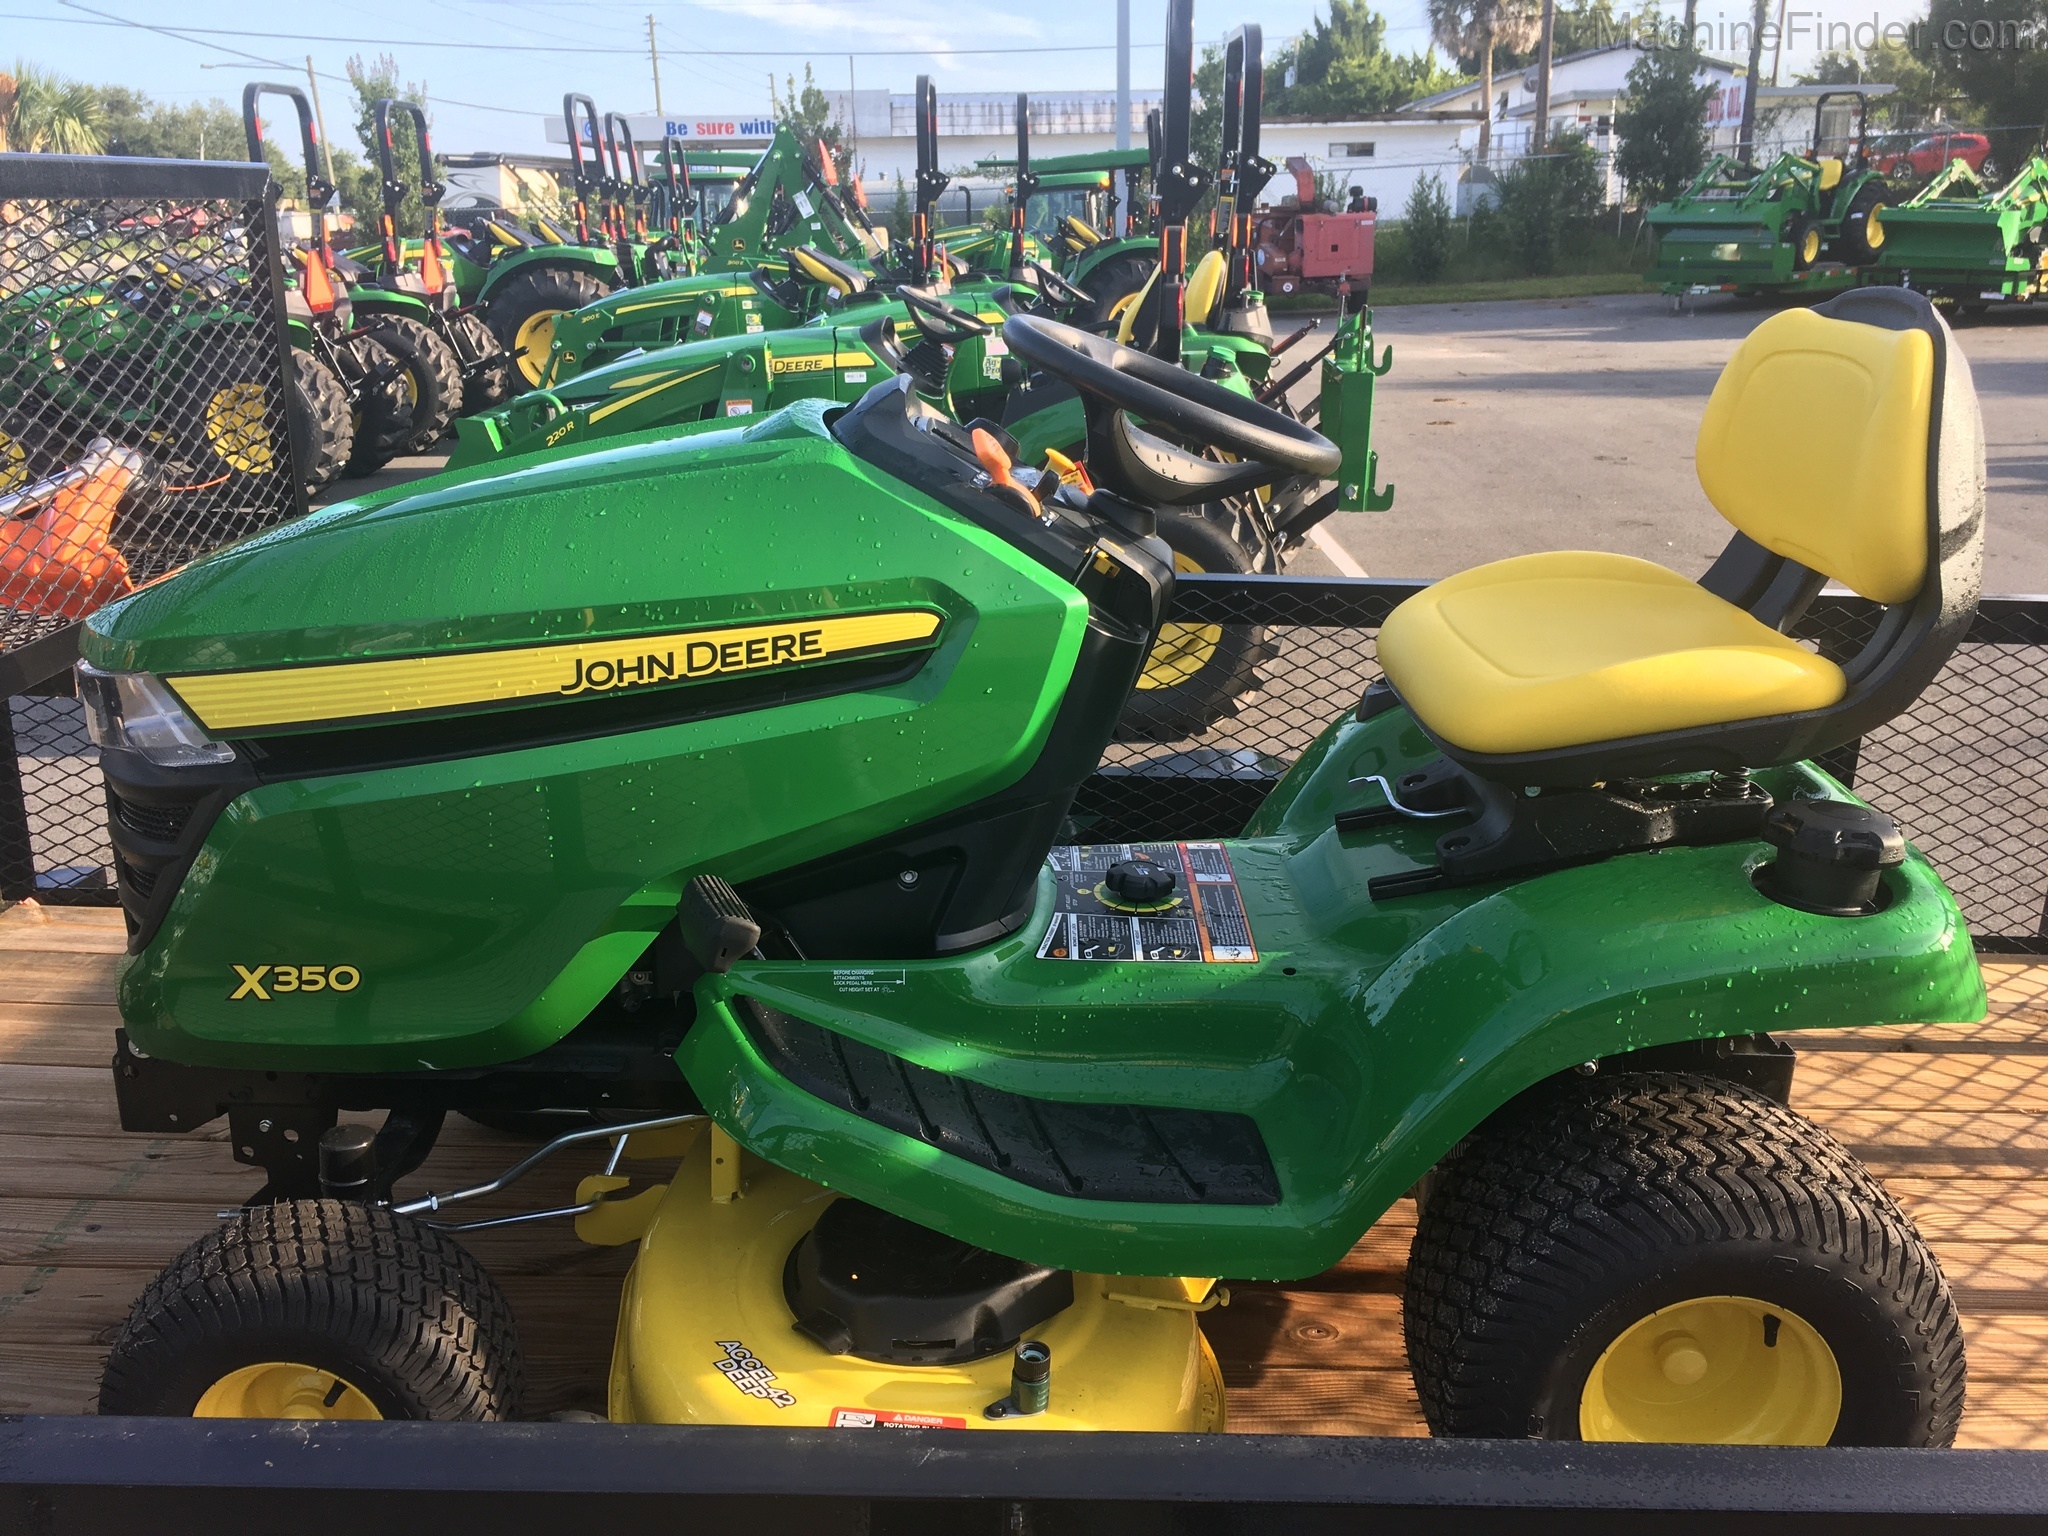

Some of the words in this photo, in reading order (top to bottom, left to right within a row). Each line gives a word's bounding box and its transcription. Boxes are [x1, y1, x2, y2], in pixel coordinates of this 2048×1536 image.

[665, 121, 688, 136] Be
[696, 121, 735, 136] sure
[740, 118, 776, 135] with
[773, 359, 823, 372] DEERE
[546, 426, 566, 447] 220
[566, 420, 575, 433] R
[561, 651, 676, 692] JOHN
[686, 629, 823, 675] DEERE
[228, 964, 361, 1000] X350
[714, 1340, 778, 1390] ACCEL
[712, 1358, 768, 1399] DEEP
[765, 1387, 797, 1409] 42
[903, 1414, 944, 1425] DANGER
